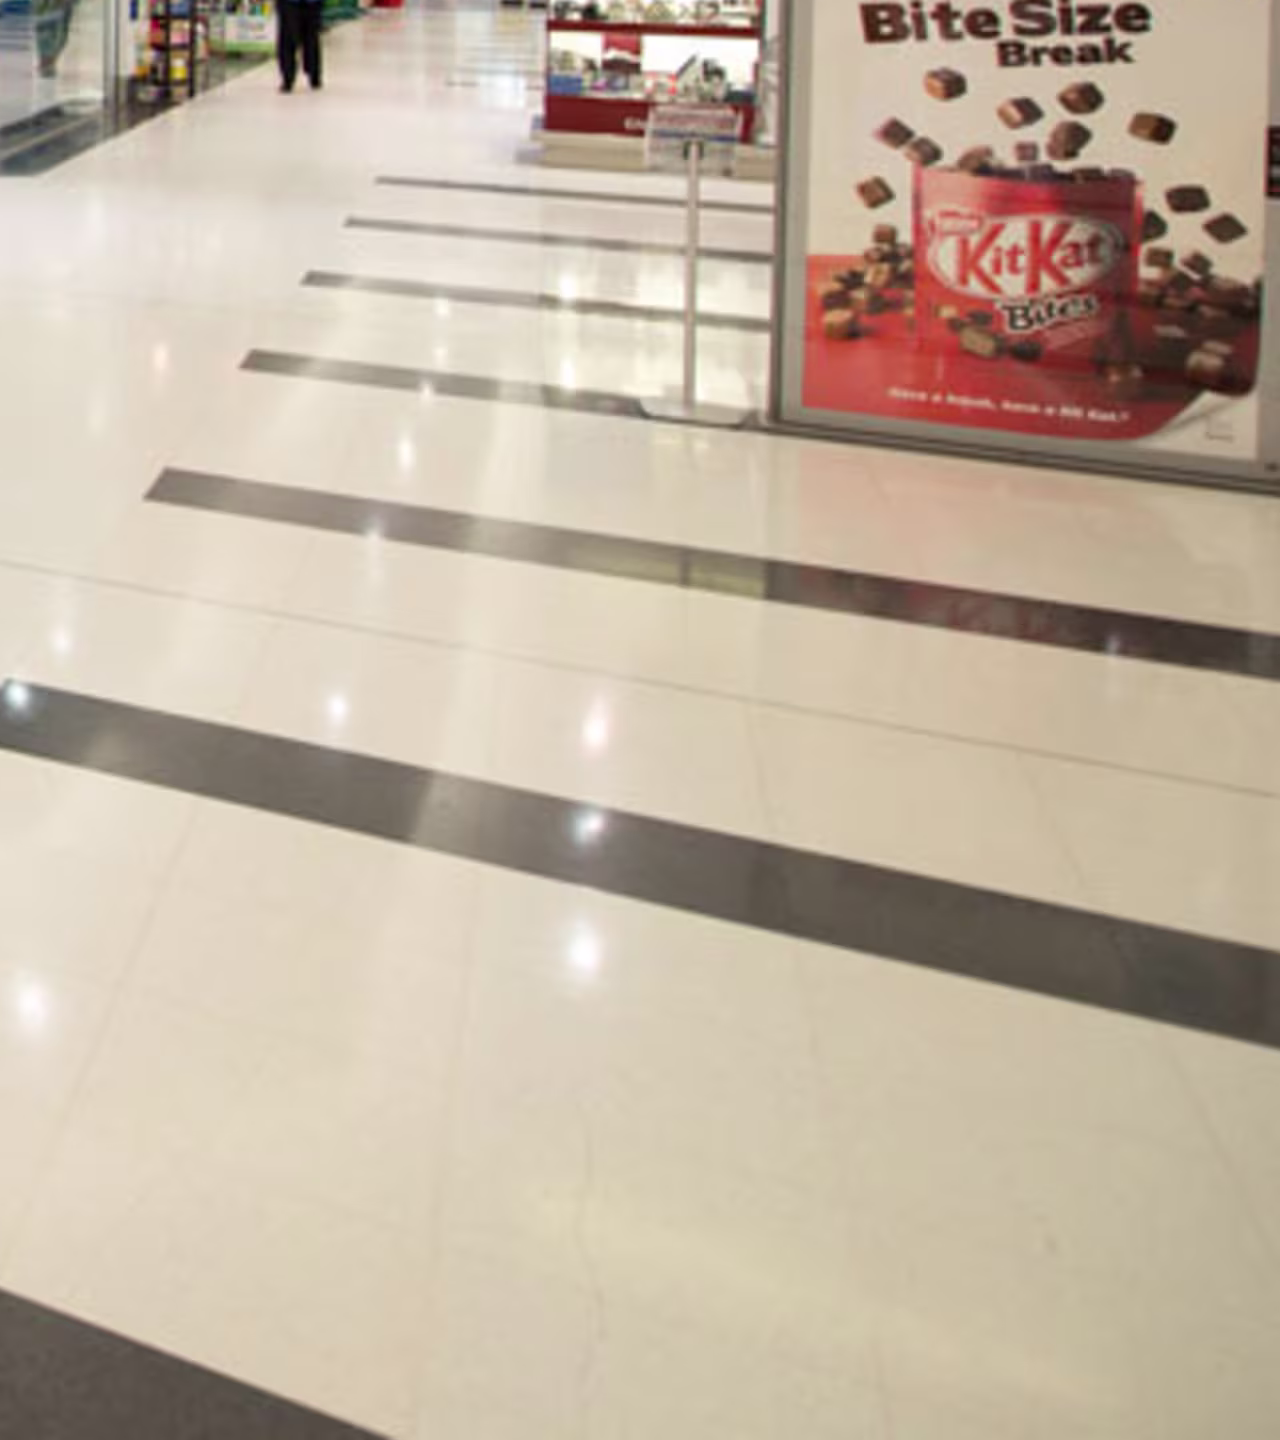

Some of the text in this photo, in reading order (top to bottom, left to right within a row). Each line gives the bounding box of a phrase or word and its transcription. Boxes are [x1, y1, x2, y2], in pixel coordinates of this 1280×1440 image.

[859, 0, 1001, 45] Bite
[996, 37, 1136, 69] Break
[957, 220, 1108, 295] KitKat
[1000, 295, 1098, 332] Bites
